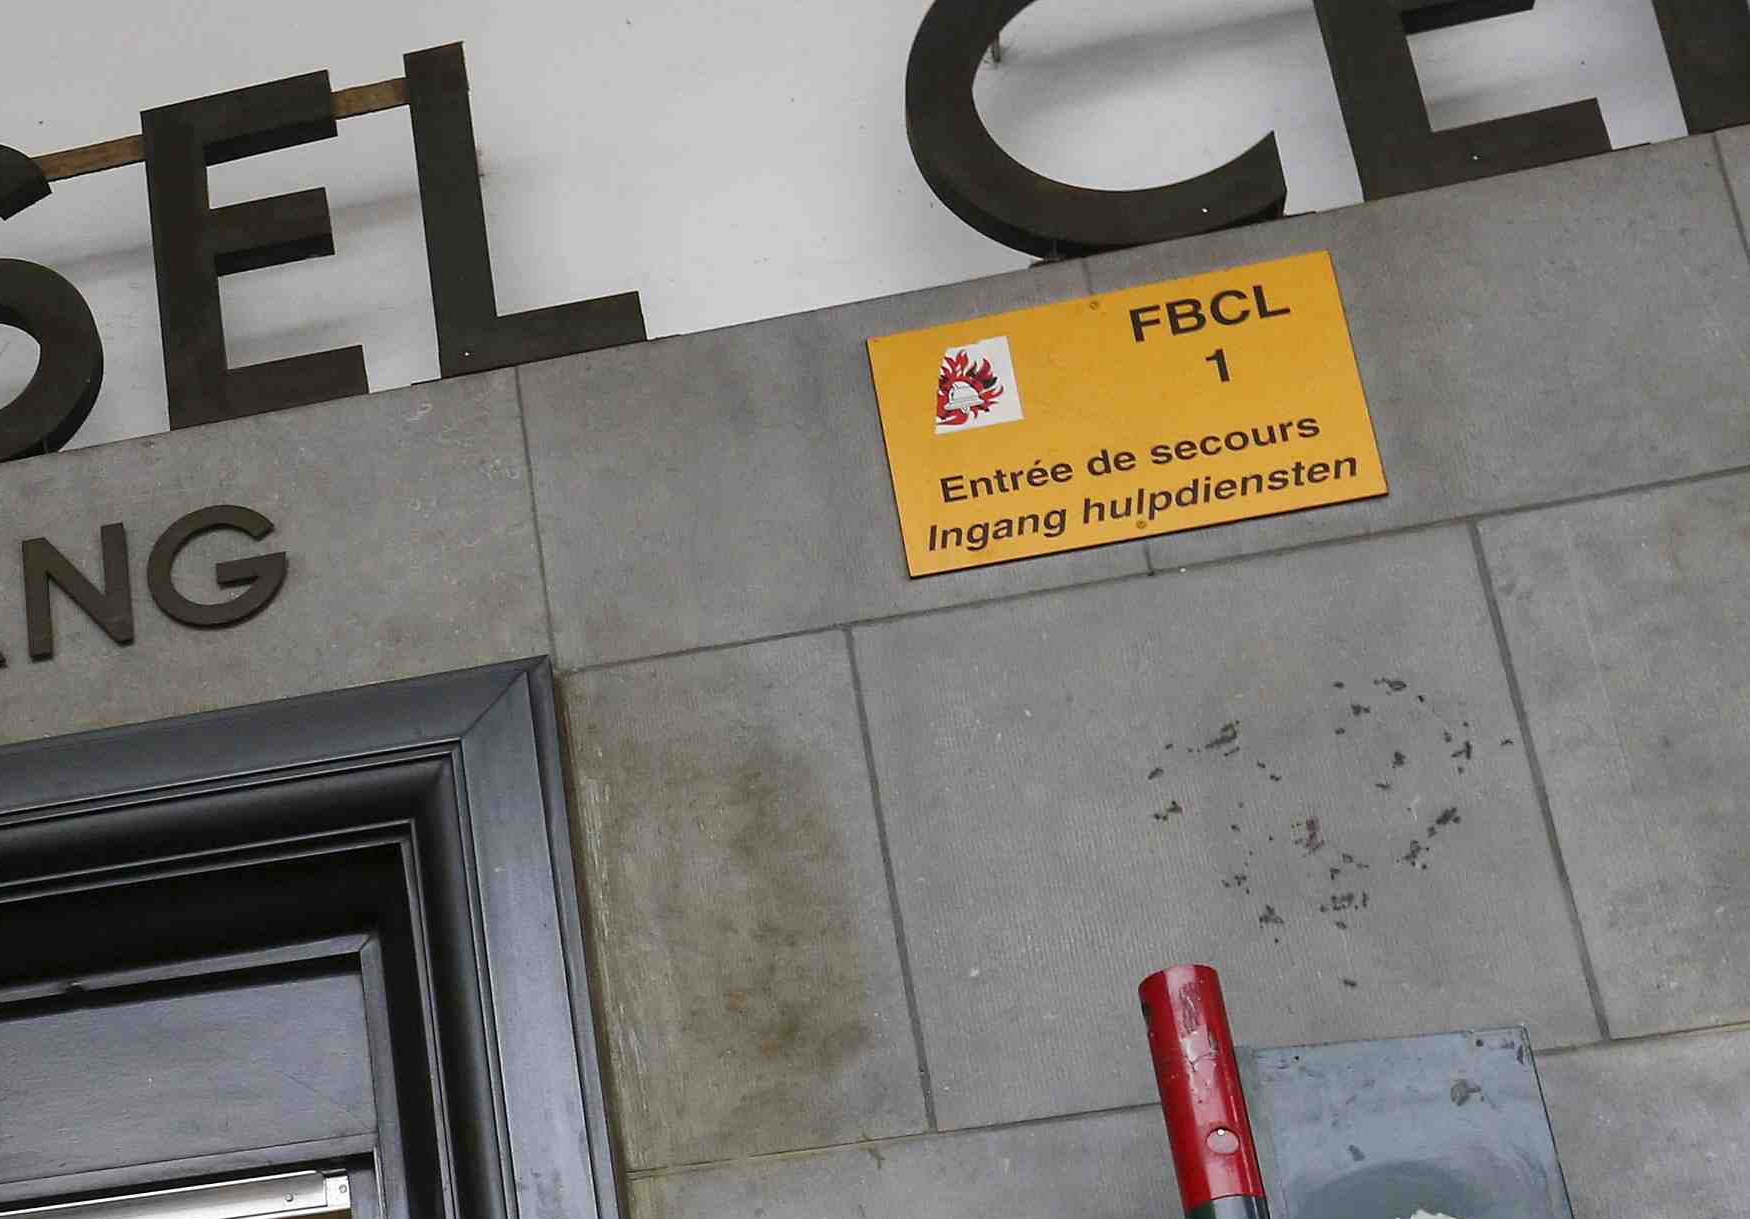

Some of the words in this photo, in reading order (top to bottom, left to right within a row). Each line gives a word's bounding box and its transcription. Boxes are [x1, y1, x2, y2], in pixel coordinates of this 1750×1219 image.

[905, 0, 1750, 262] CE
[1129, 283, 1291, 344] FBCL
[1205, 347, 1233, 384] 1
[927, 508, 1067, 554] Ingang
[1082, 453, 1359, 526] hulpdiensten
[939, 456, 1073, 504] Entrée
[1087, 440, 1137, 478] de
[1151, 415, 1321, 467] secours
